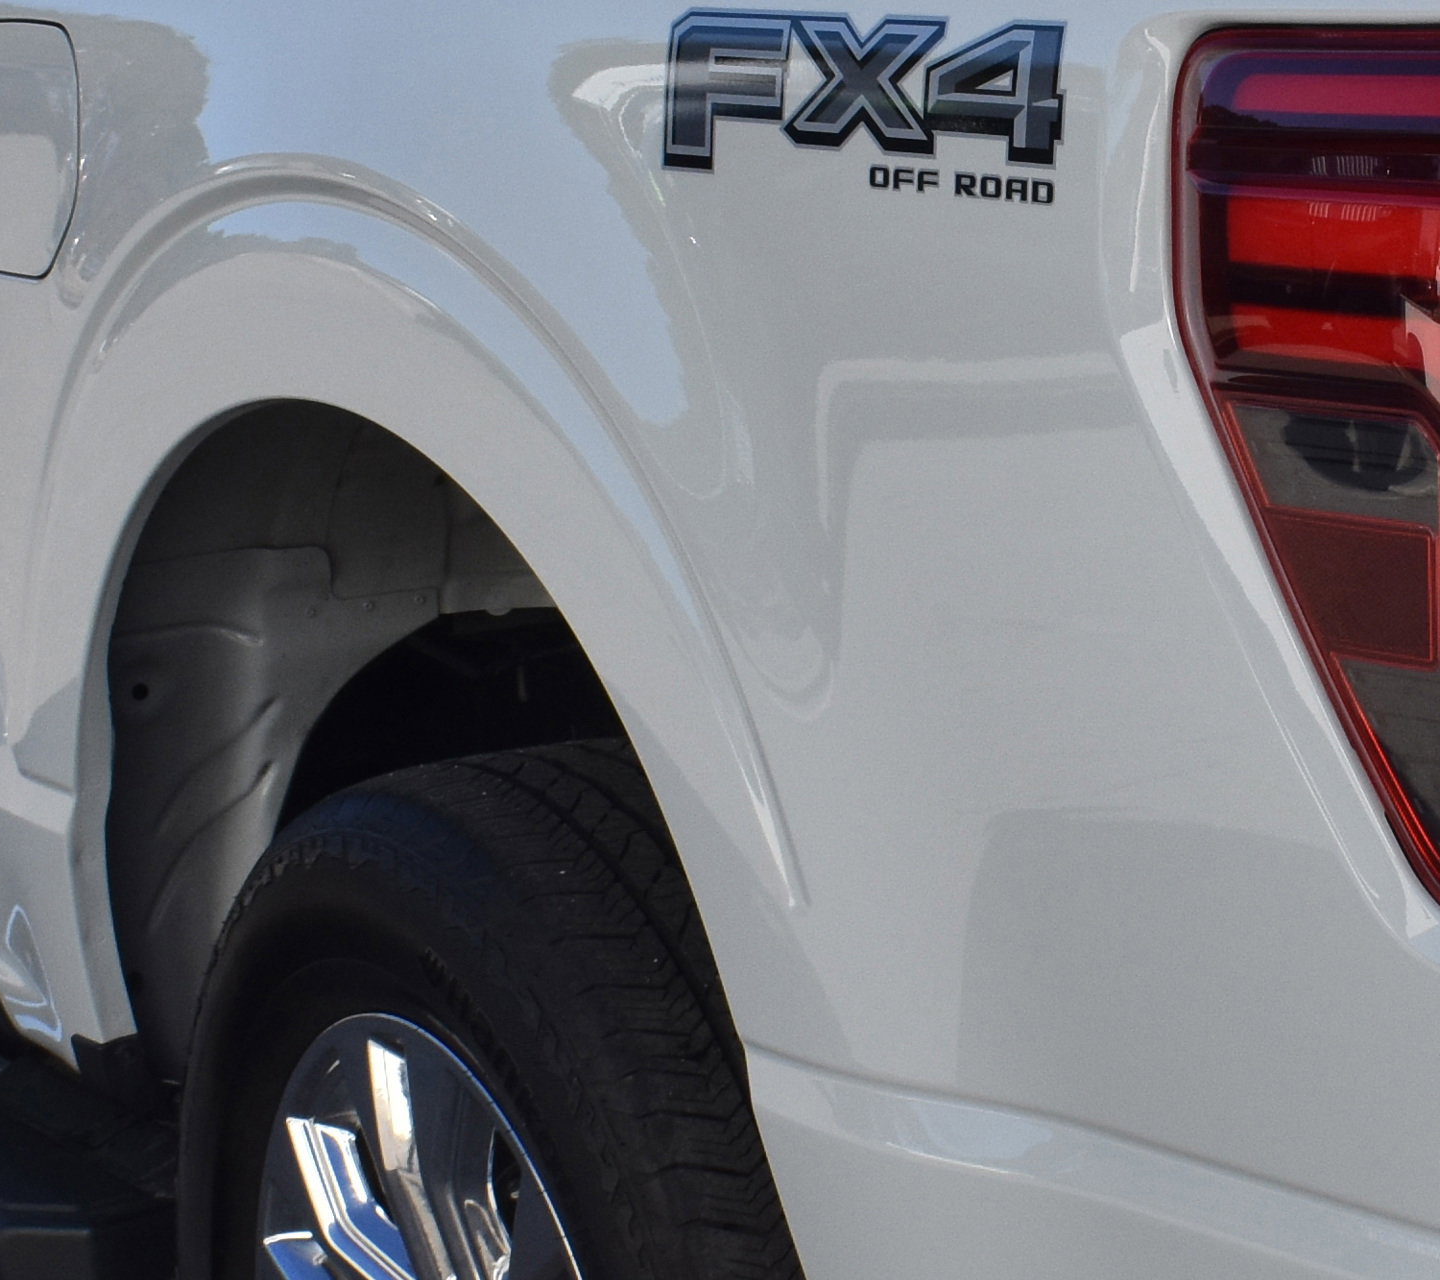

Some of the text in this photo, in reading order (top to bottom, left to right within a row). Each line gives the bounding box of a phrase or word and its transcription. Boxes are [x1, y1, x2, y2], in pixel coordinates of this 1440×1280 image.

[662, 6, 1067, 174] FX4
[868, 163, 1055, 206] OFF ROAD
